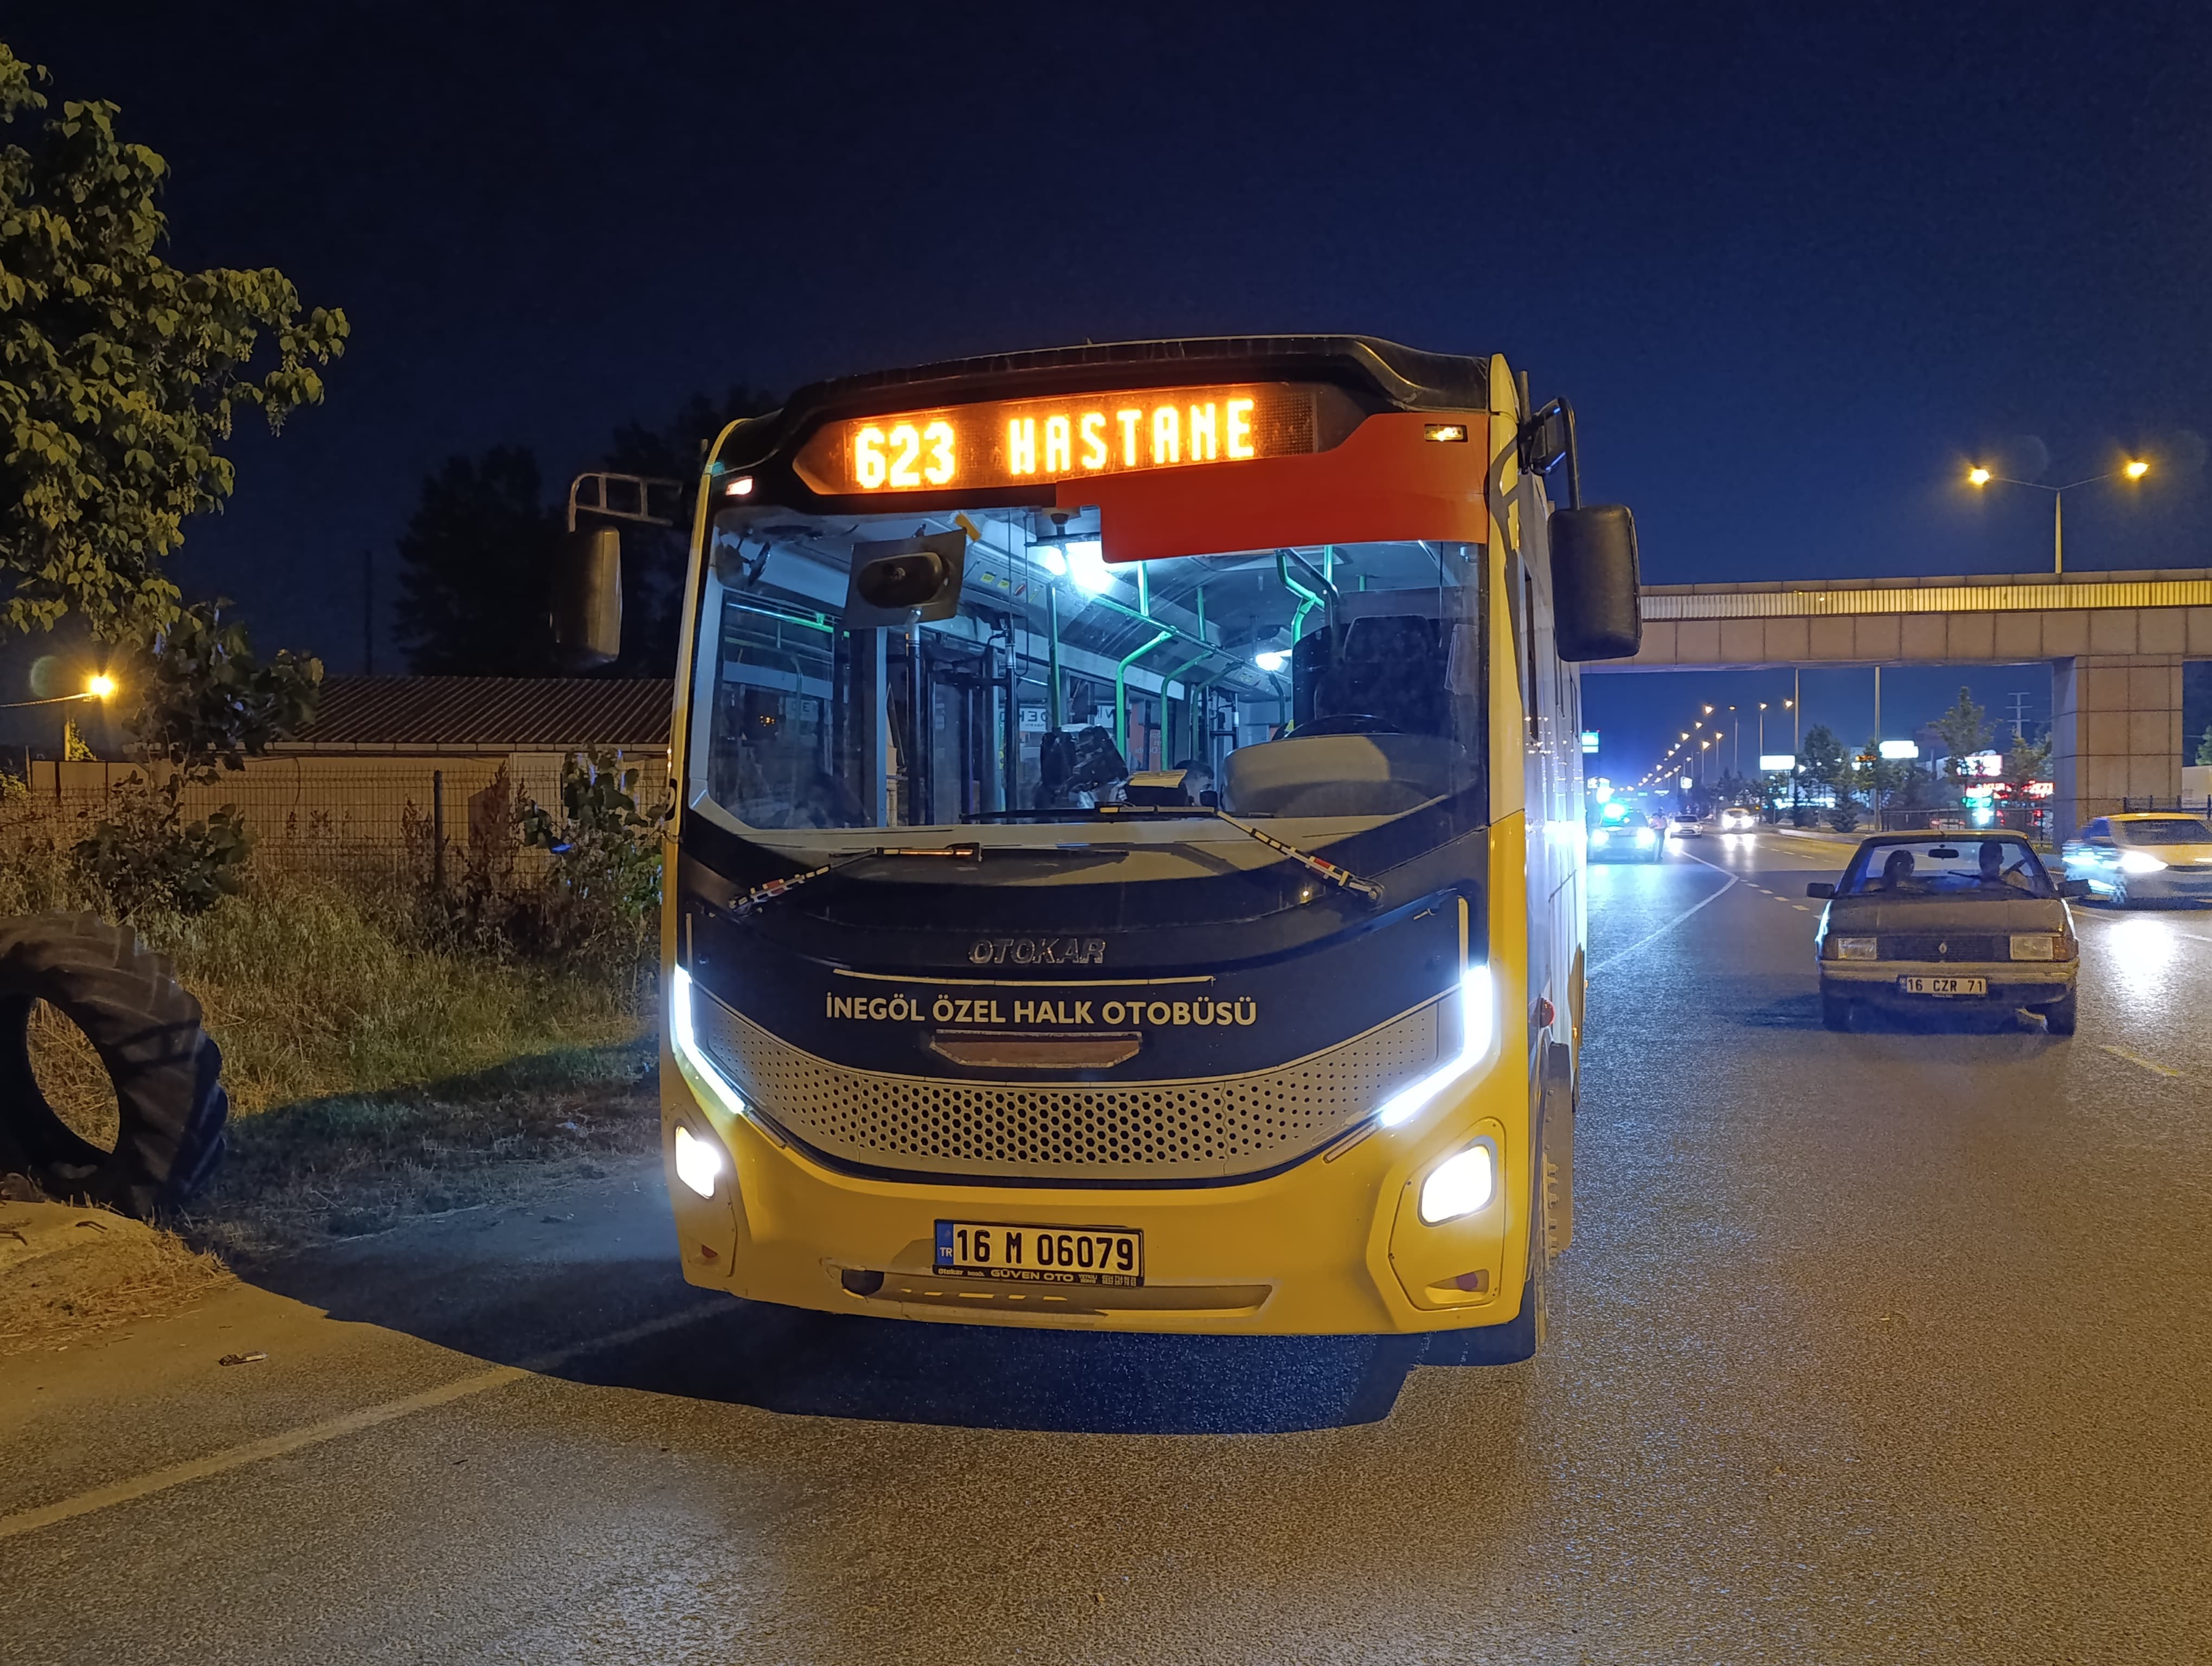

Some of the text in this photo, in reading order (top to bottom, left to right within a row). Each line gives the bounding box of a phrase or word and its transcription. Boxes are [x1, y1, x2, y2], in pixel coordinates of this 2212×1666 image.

[854, 398, 1255, 488] 623 HASTANE
[968, 938, 1107, 964] OTOKAR
[1908, 979, 1983, 992] 16 CZR 71
[826, 992, 1257, 1026] İNEGÖL ÖZEL HALK OTOBÜSÜ
[939, 1247, 953, 1257] TR
[957, 1229, 1133, 1271] 16 M 06079
[991, 1269, 1040, 1280] GÜVEN
[1043, 1272, 1073, 1282] OTO
